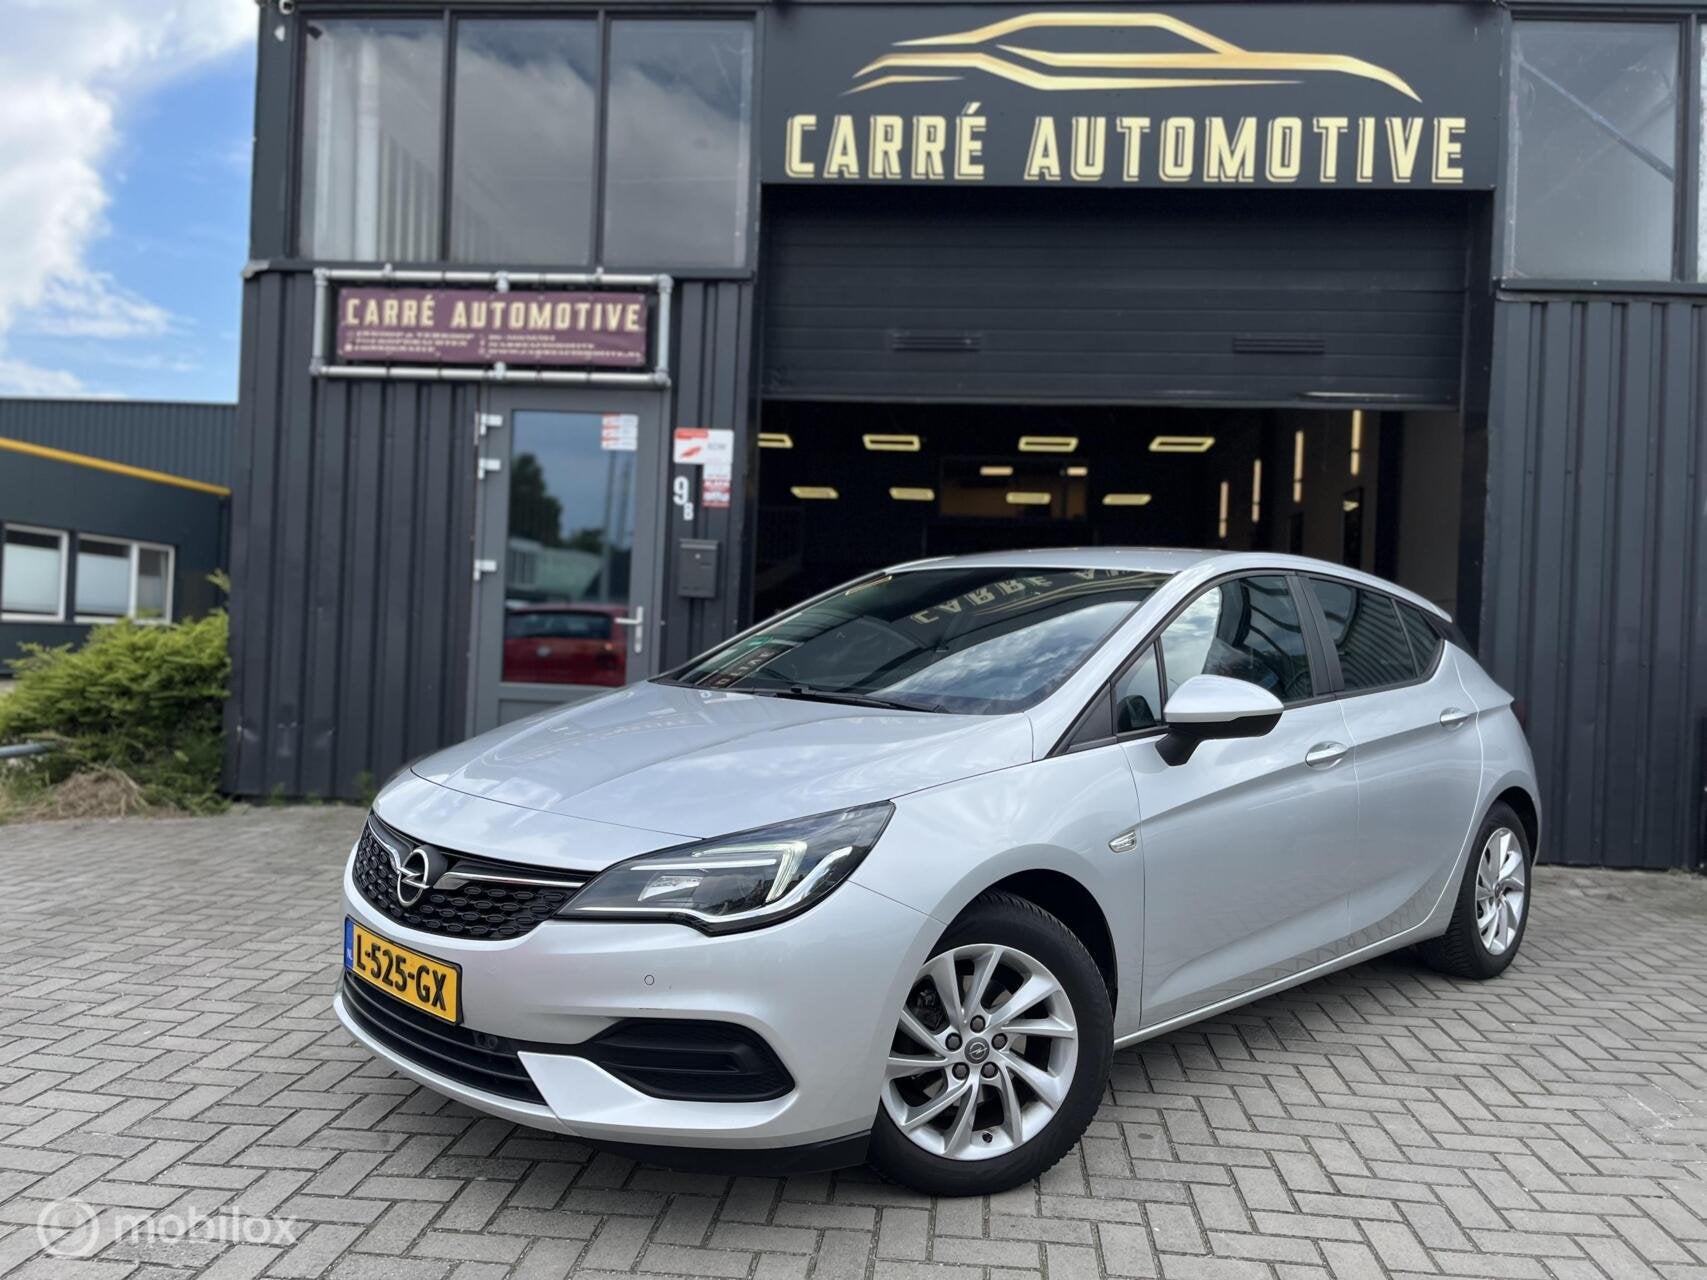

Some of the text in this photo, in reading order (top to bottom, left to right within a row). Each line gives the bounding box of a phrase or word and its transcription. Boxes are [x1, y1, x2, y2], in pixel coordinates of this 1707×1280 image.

[784, 102, 1467, 184] CARRÉ AUTOMOTIVE
[346, 295, 641, 331] CARRÉ AUTOMOTIVE
[673, 476, 689, 505] 9
[356, 933, 447, 1012] L-525-GX
